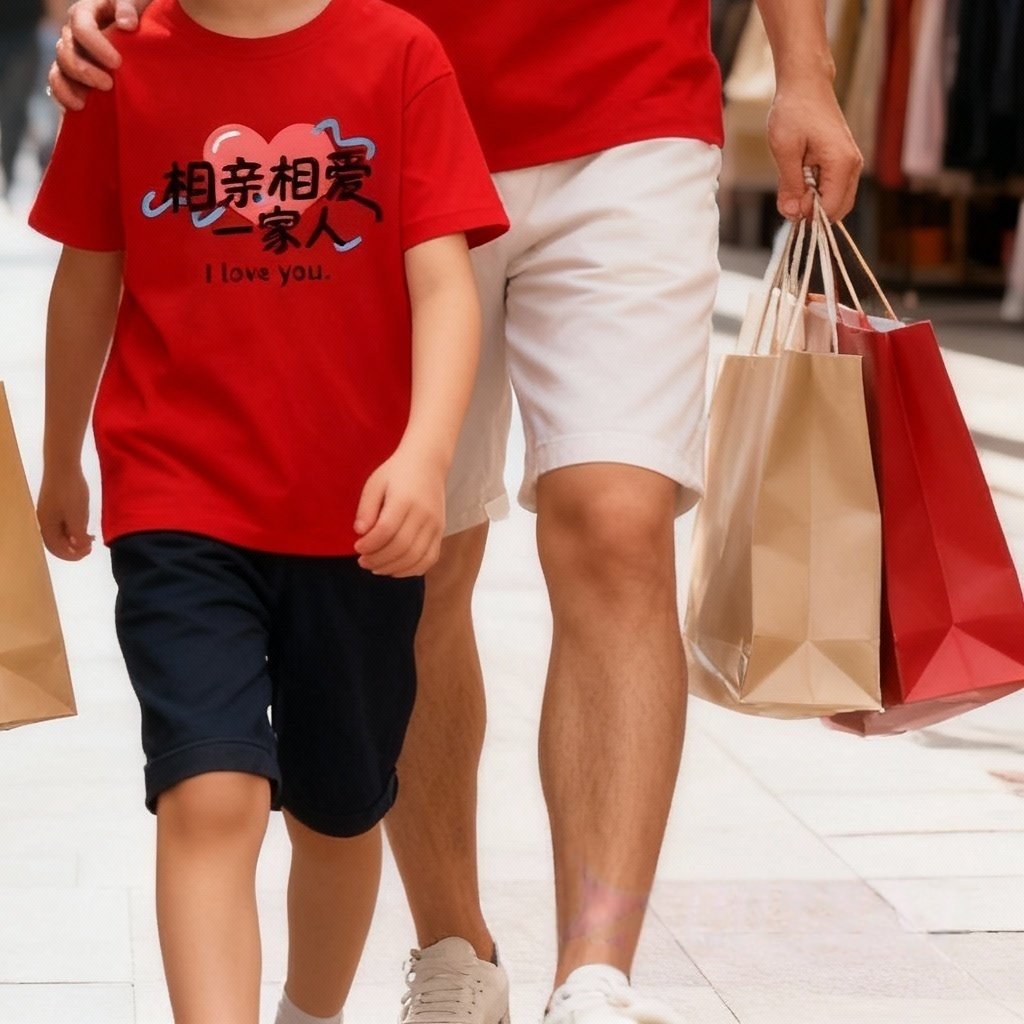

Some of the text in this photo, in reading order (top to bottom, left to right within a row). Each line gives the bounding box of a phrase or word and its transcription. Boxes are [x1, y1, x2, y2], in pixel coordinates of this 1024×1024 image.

[163, 148, 383, 223] 相亲相爱
[212, 205, 345, 255] 一家人
[205, 261, 330, 287] I love you.
